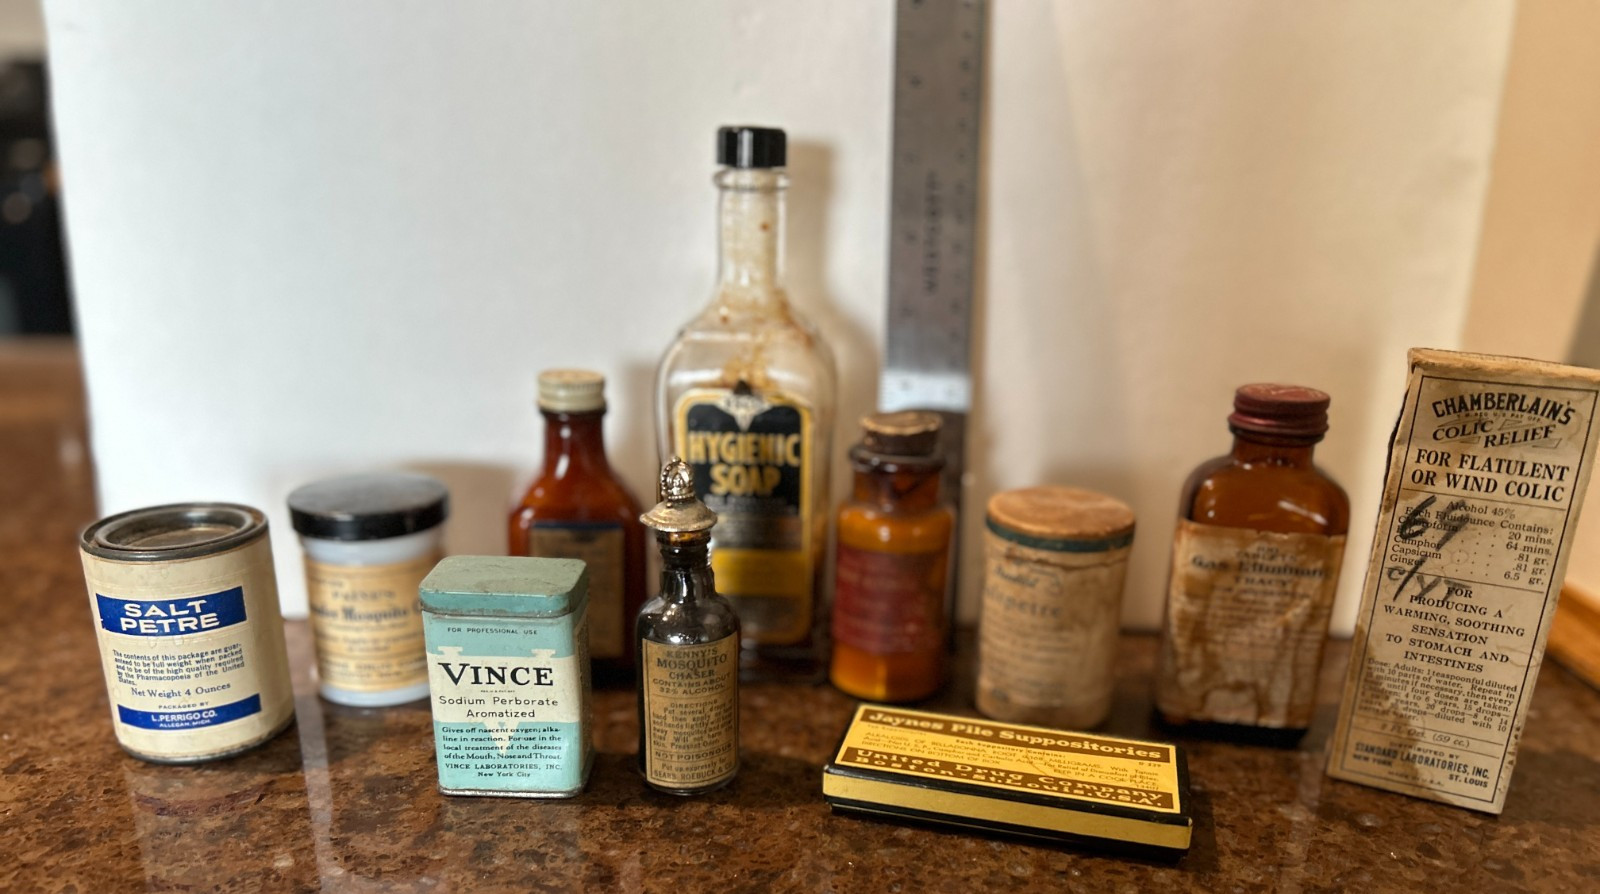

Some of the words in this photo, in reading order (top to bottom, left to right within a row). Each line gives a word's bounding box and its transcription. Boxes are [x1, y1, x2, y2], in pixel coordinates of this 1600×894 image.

[1432, 392, 1576, 426] CHAMBERLAIN'S
[1432, 420, 1494, 441] COLIC
[1484, 424, 1556, 448] RELIEF
[687, 431, 801, 467] HYGIENIC
[1415, 448, 1451, 467] FOR
[1457, 453, 1570, 482] FLATULENT
[709, 462, 782, 497] SOAP
[1411, 468, 1437, 486] OR
[1446, 472, 1498, 493] WIND
[1505, 480, 1564, 502] COLIC
[1491, 508, 1516, 520] 45%
[1500, 520, 1554, 535] Contains:
[1508, 531, 1521, 541] 20
[1525, 533, 1555, 546] mins.
[1394, 536, 1442, 549] Camphor
[1514, 551, 1529, 561] .81
[1533, 557, 1549, 567] gr.
[1506, 541, 1519, 550] 64
[1523, 543, 1552, 556] mins.
[1391, 544, 1442, 559] Capsicum
[1512, 562, 1528, 573] .81
[1531, 567, 1547, 576] gr.
[1504, 571, 1520, 581] 6.5
[1528, 578, 1544, 586] gr.
[1447, 587, 1473, 598] FOR
[124, 599, 207, 618] SALT
[1409, 595, 1487, 616] PRODUCING
[1494, 609, 1503, 618] A
[120, 612, 220, 634] PETRE
[1384, 605, 1450, 625] WARMING,
[1455, 617, 1525, 637] SOOTHING
[1411, 624, 1489, 645] SENSATION
[161, 652, 176, 660] this
[178, 651, 208, 661] package
[223, 643, 241, 654] guar-
[667, 647, 718, 659] KENNY'S
[1386, 634, 1402, 643] TO
[1409, 638, 1472, 657] STOMACH
[1479, 651, 1510, 663] AND
[166, 660, 192, 668] weight
[195, 656, 215, 664] when
[218, 649, 243, 660] packed
[166, 667, 184, 676] high
[186, 663, 212, 673] quality
[214, 655, 244, 668] required
[656, 653, 728, 671] MOSQUITO
[1403, 651, 1484, 673] INTESTINES
[137, 673, 191, 682] Pharmacopoeia
[222, 661, 245, 672] United
[438, 662, 554, 687] VINCE
[653, 678, 700, 688] CONTAINS
[703, 672, 731, 686] ABOUT
[669, 669, 715, 680] CHASER
[131, 687, 145, 697] Net
[147, 688, 182, 699] Weight
[185, 688, 191, 696] 4
[195, 682, 231, 695] Ounces
[682, 684, 725, 695] ALCOHOL
[1432, 670, 1484, 686] teaspoonful
[1485, 680, 1518, 693] diluted
[439, 695, 485, 705] Sodium
[493, 696, 559, 707] Perborate
[1466, 691, 1487, 700] then
[1488, 696, 1514, 707] every
[1471, 684, 1502, 696] Repeat
[1506, 691, 1515, 699] in
[202, 709, 218, 718] CO.
[466, 709, 536, 718] Aromatized
[1483, 701, 1511, 713] taken.
[442, 726, 463, 734] Gives
[868, 712, 944, 730] Jaynes
[951, 722, 994, 737] Pile
[999, 730, 1162, 759] Suppositories
[655, 751, 673, 759] NOT
[677, 743, 731, 760] POISONOUS
[856, 749, 941, 768] United
[955, 764, 1024, 781] Drug
[1038, 776, 1163, 800] Company
[1400, 751, 1470, 776] LABORATORIES,
[1472, 766, 1490, 779] INC.
[1448, 774, 1462, 783] ST.
[1464, 778, 1488, 788] LOUIS
